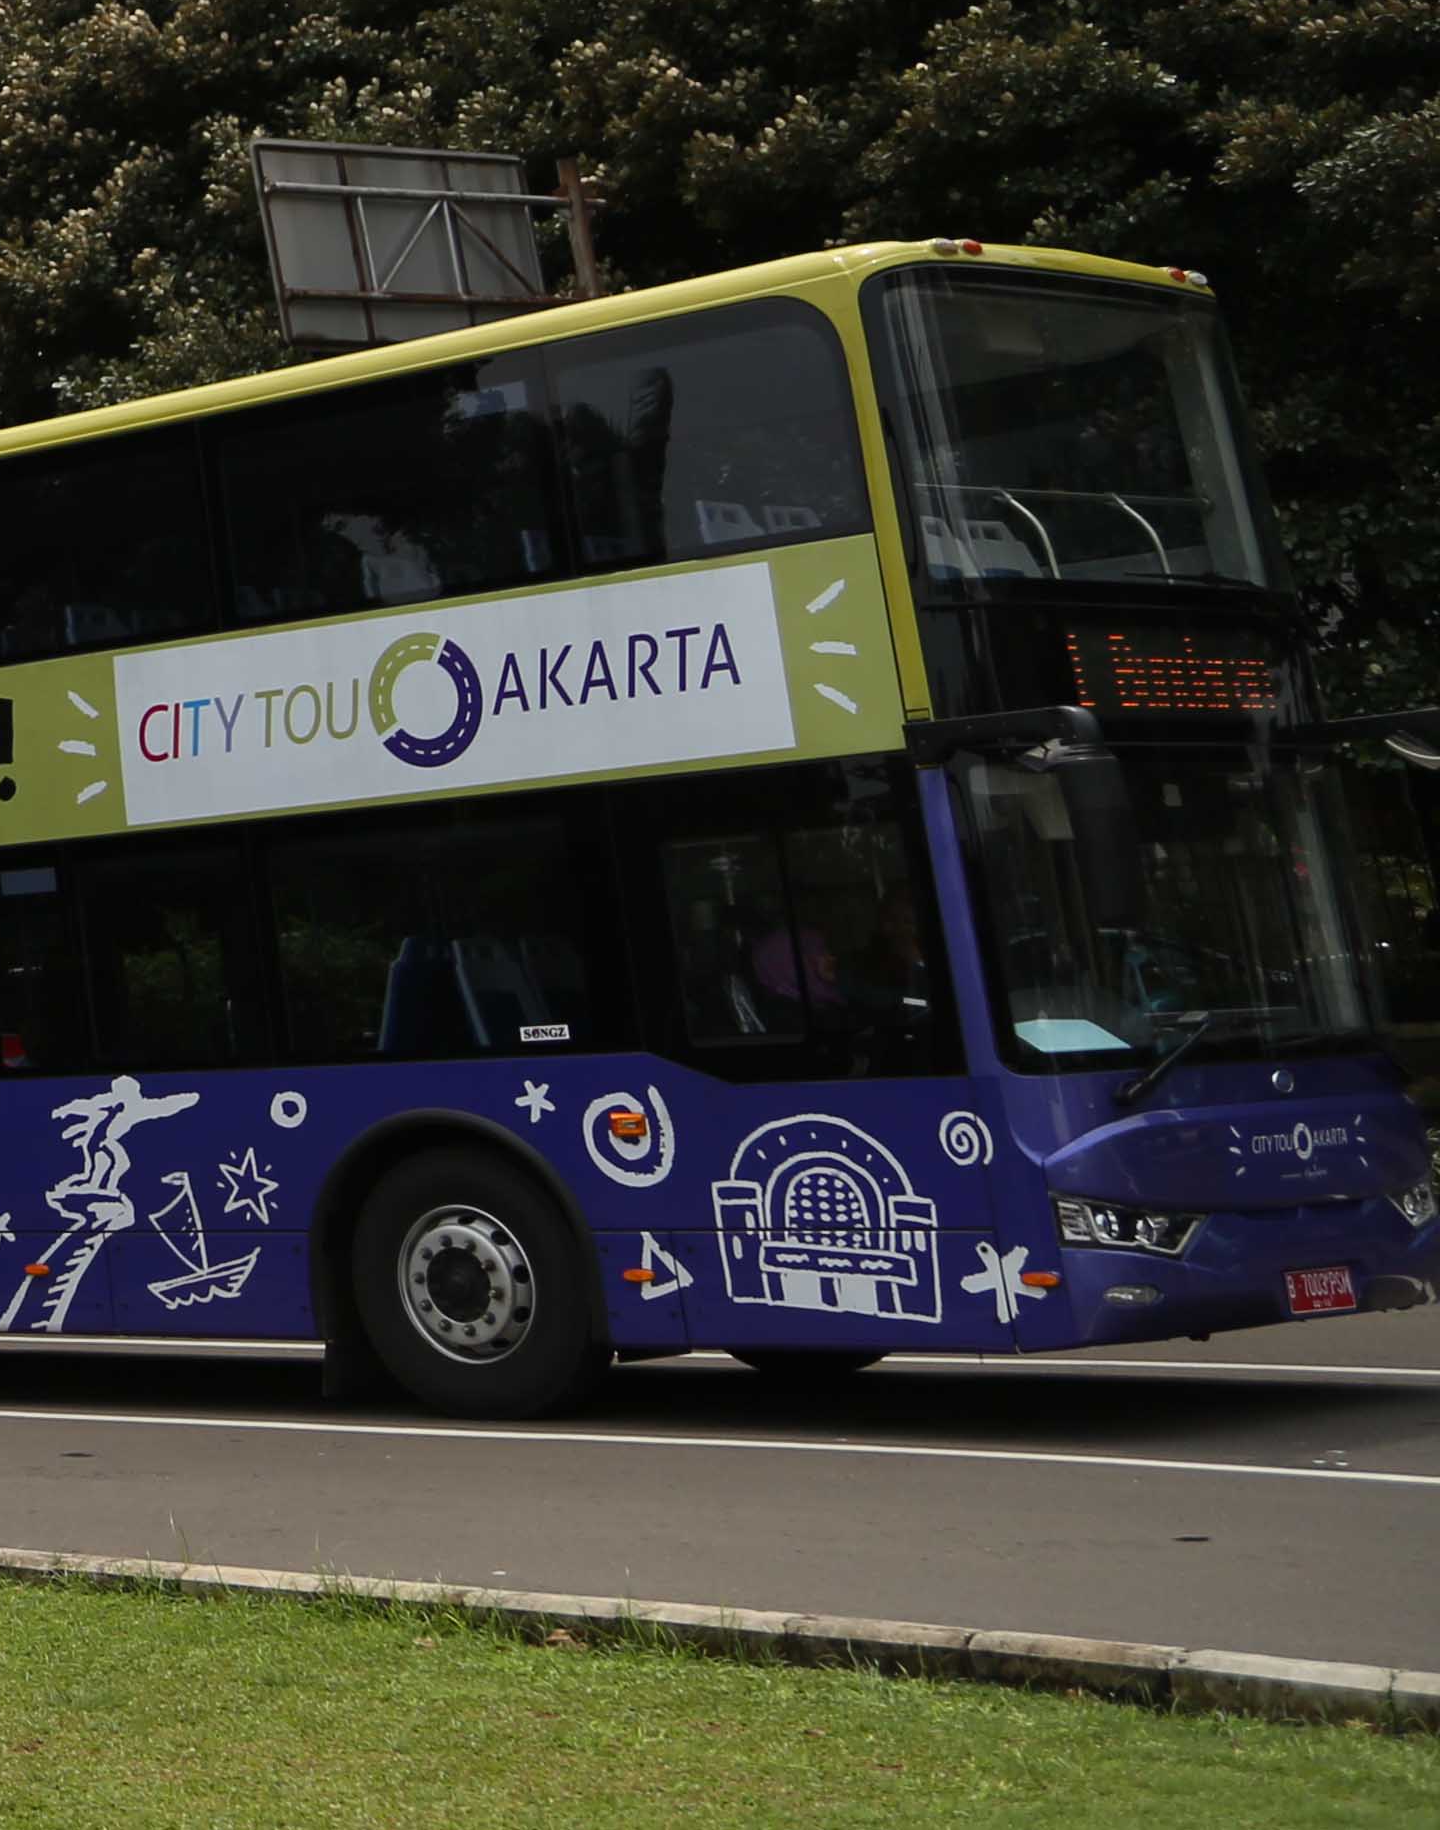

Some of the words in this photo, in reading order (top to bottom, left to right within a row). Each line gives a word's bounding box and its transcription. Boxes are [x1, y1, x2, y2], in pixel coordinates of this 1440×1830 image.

[138, 692, 246, 763] CITY
[522, 1026, 567, 1040] SONGZ
[1287, 1274, 1296, 1299] B
